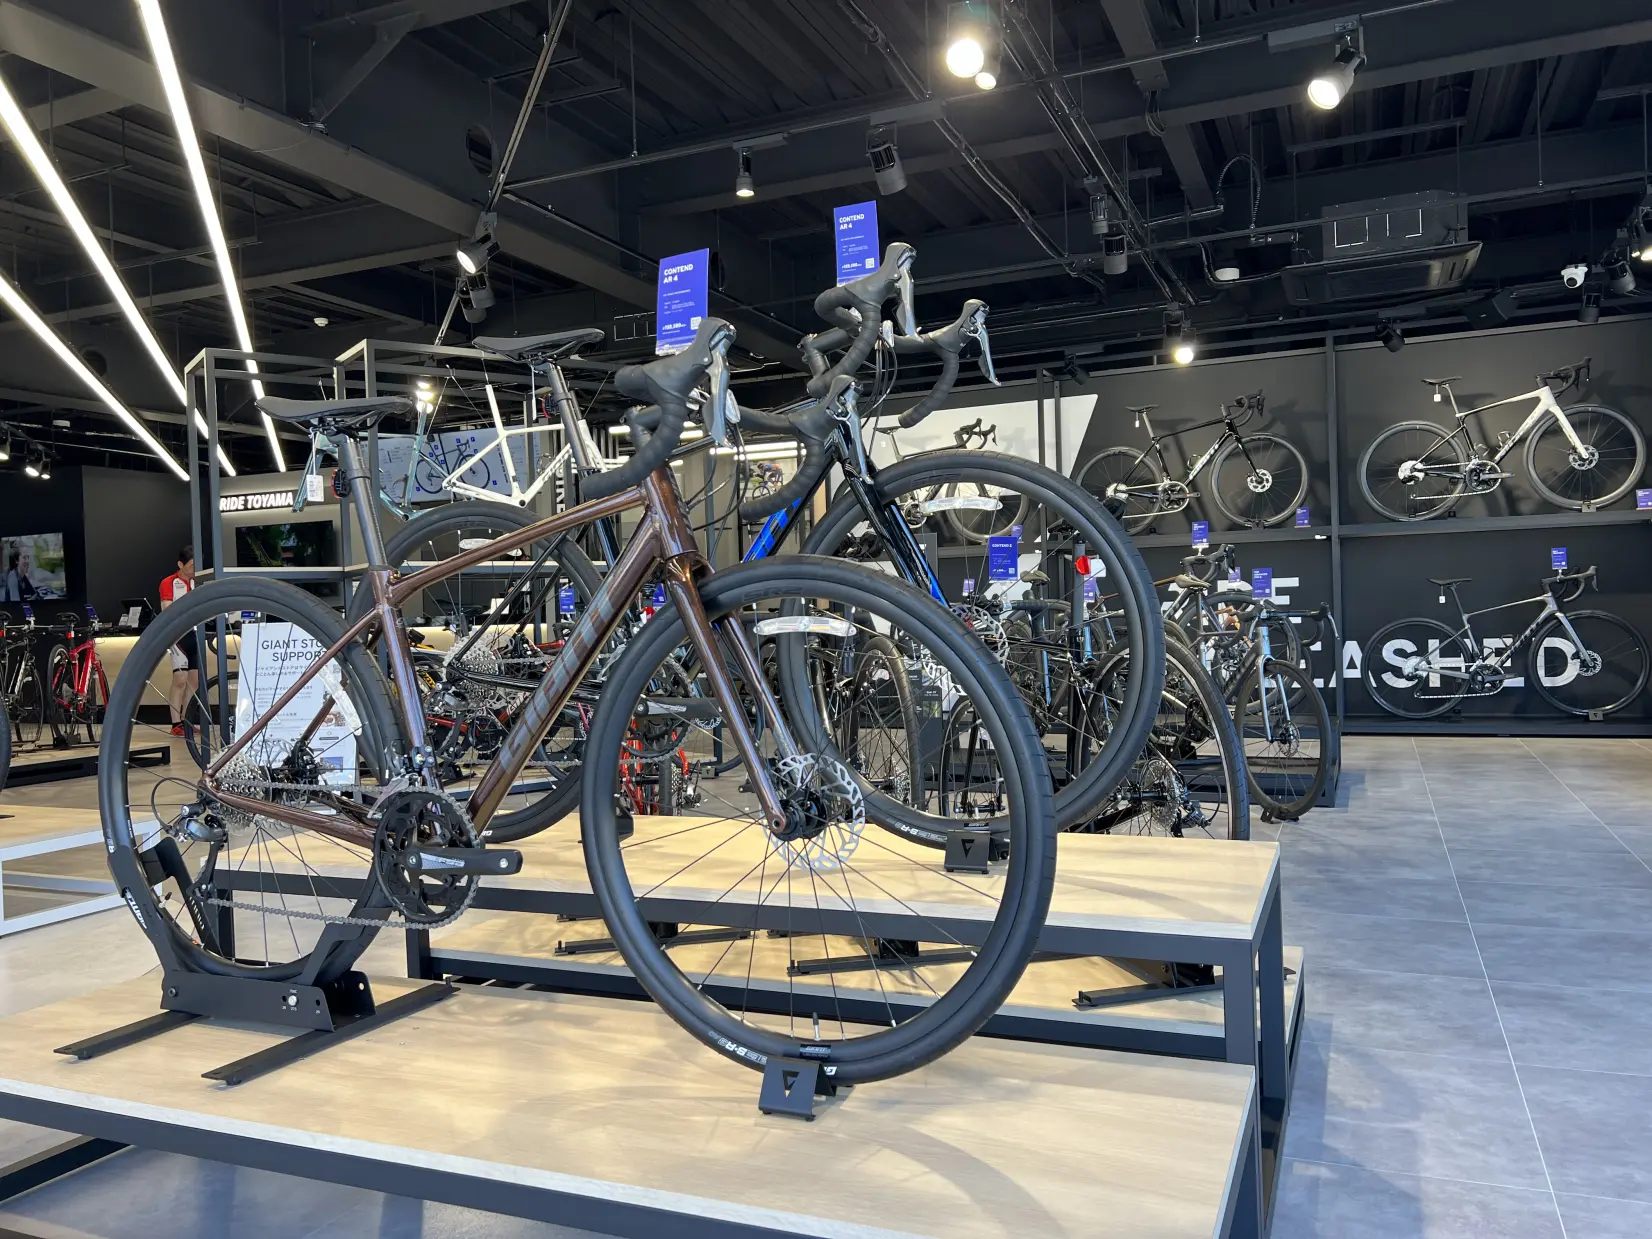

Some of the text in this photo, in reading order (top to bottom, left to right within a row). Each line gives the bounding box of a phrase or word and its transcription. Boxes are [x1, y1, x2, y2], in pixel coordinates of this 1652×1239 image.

[839, 213, 865, 223] CONTEND
[663, 263, 694, 276] CONTEND
[663, 274, 679, 284] AR 4
[219, 491, 294, 511] RIDE TOYAMA
[261, 638, 323, 650] GIANT STO
